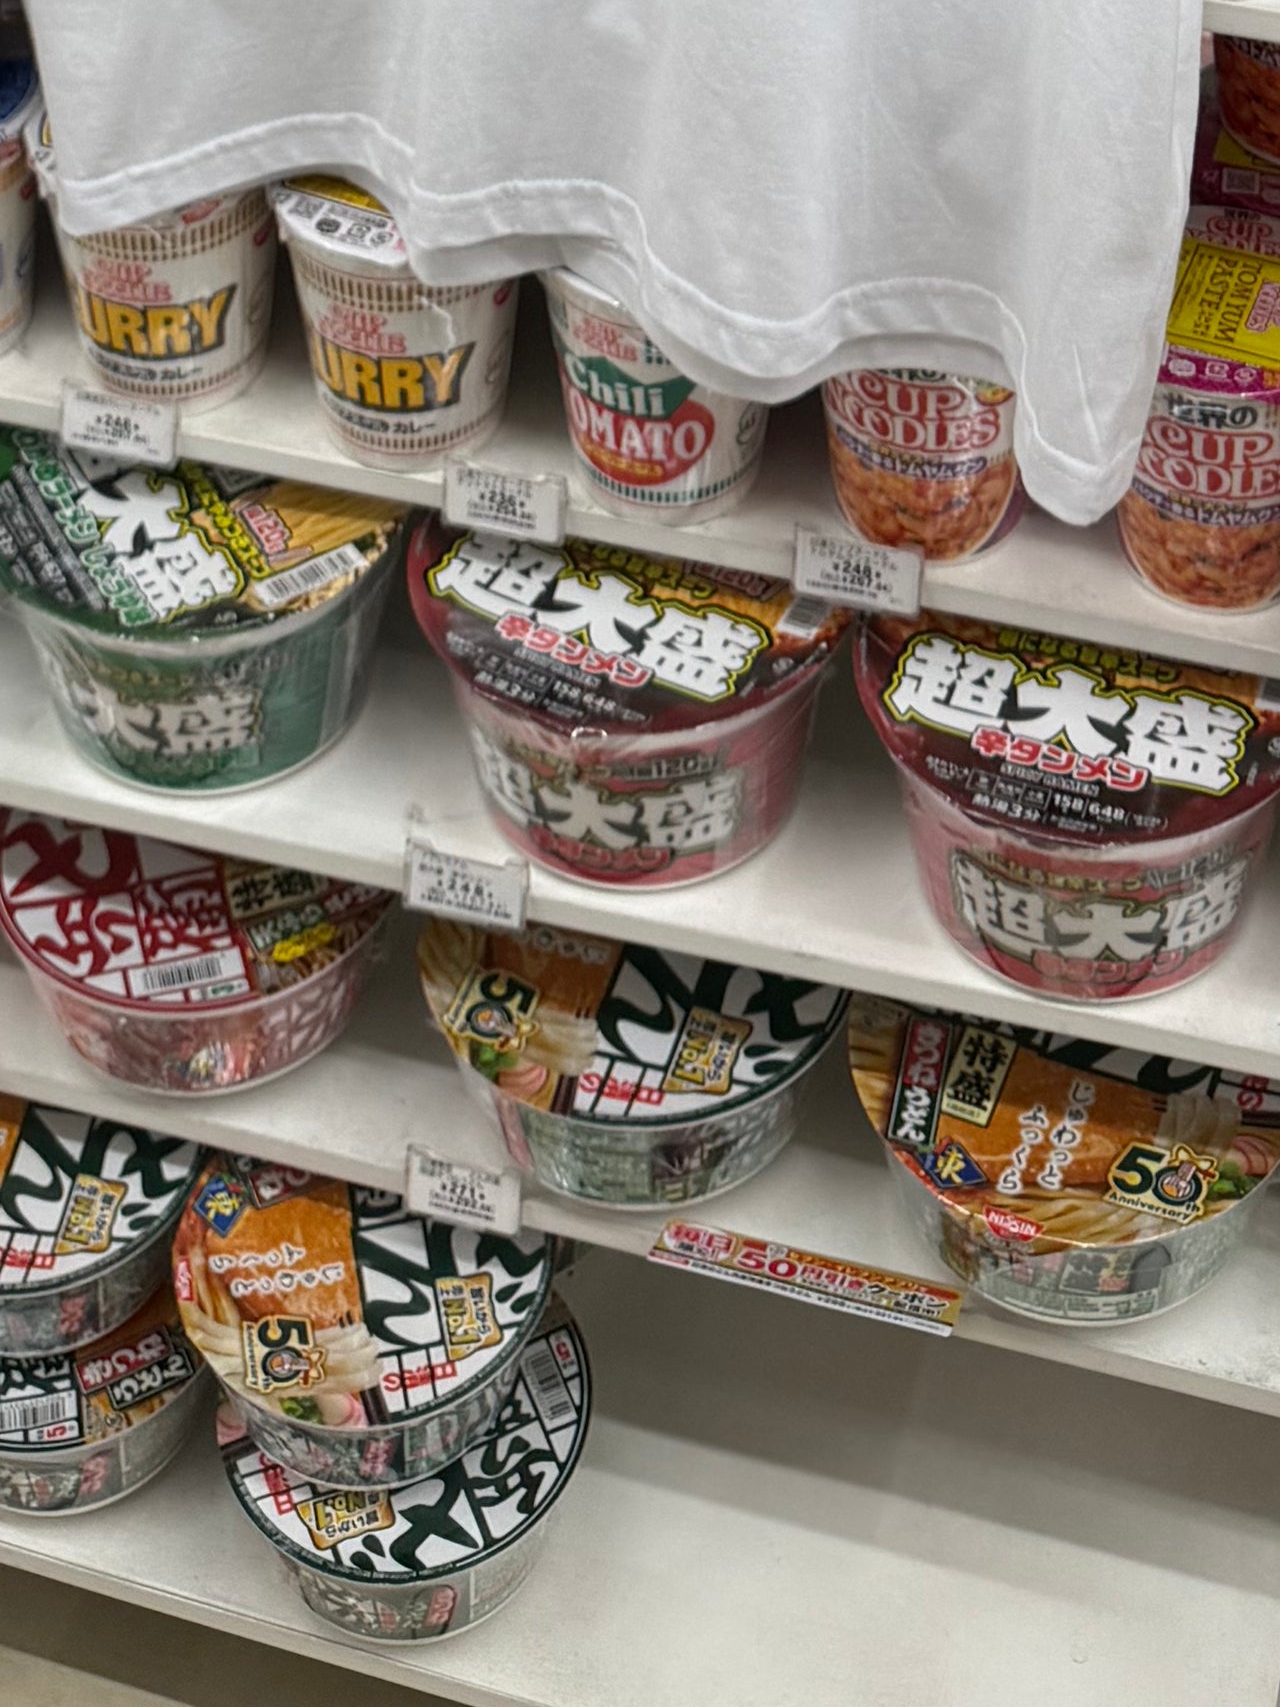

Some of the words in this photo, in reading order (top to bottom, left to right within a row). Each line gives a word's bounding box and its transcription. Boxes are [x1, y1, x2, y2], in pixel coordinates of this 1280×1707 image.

[565, 353, 665, 417] Chili
[1148, 415, 1274, 464] CUP
[429, 533, 772, 704] 超大盛
[496, 613, 651, 688] 辛タンメン
[884, 631, 1252, 796] 超大盛
[971, 725, 1152, 792] 辛タンメン
[946, 1034, 1009, 1110] 特盛
[997, 1105, 1048, 1194] ふっくら
[1038, 1081, 1094, 1189] じゅわっと
[987, 1208, 1038, 1237] NISSIN
